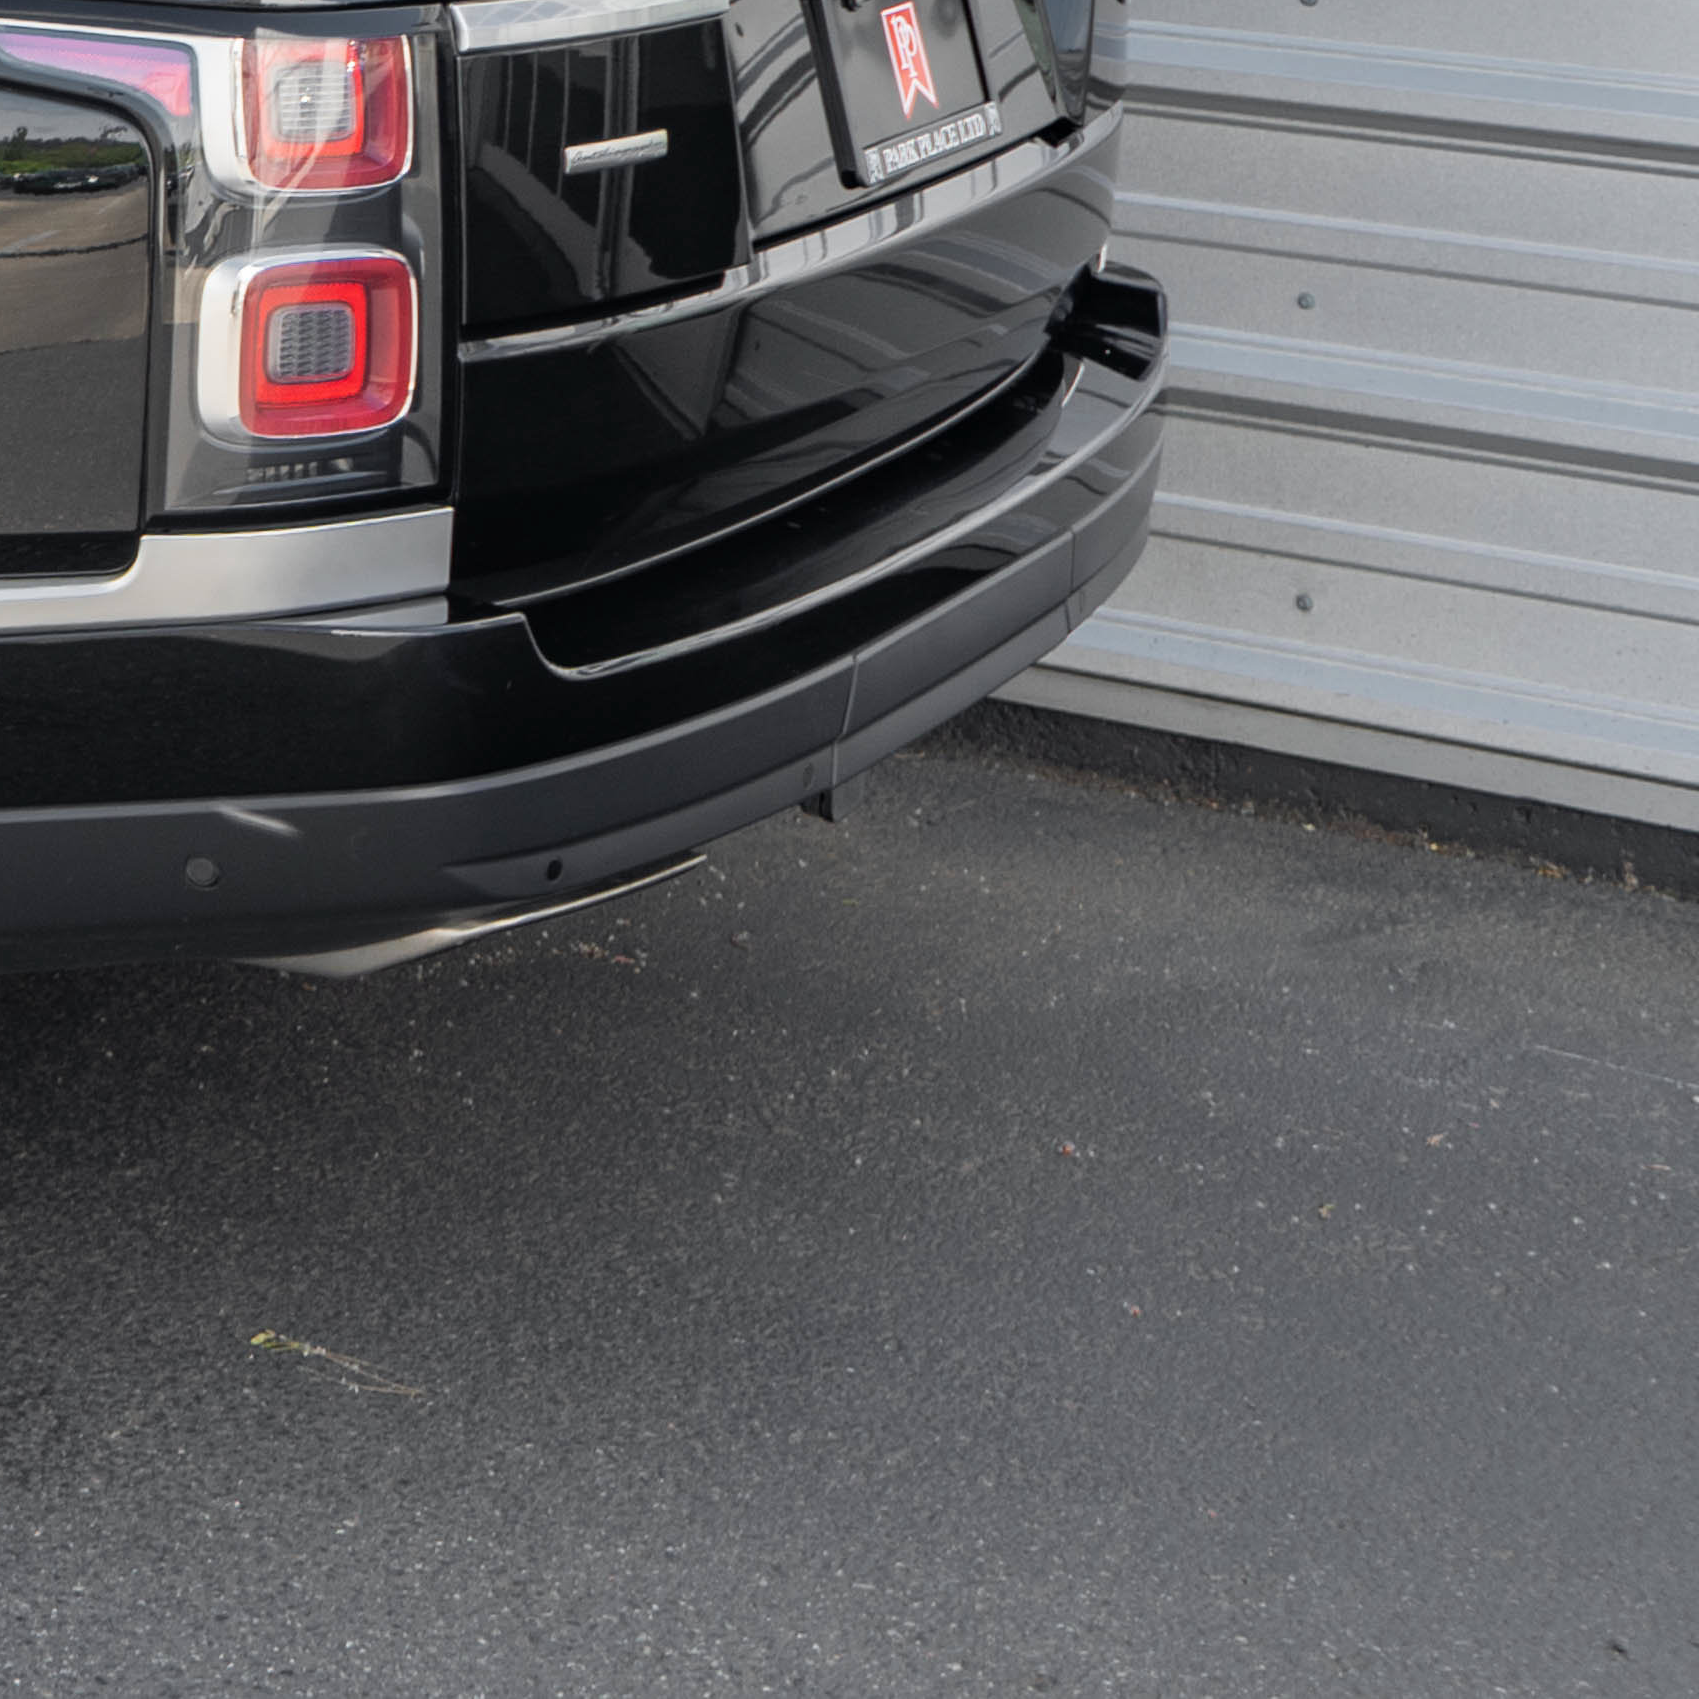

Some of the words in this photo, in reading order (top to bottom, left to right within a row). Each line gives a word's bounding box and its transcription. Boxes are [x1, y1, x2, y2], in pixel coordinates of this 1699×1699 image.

[882, 140, 921, 174] PARK
[918, 122, 960, 161] PLACE
[957, 112, 988, 143] LTD
